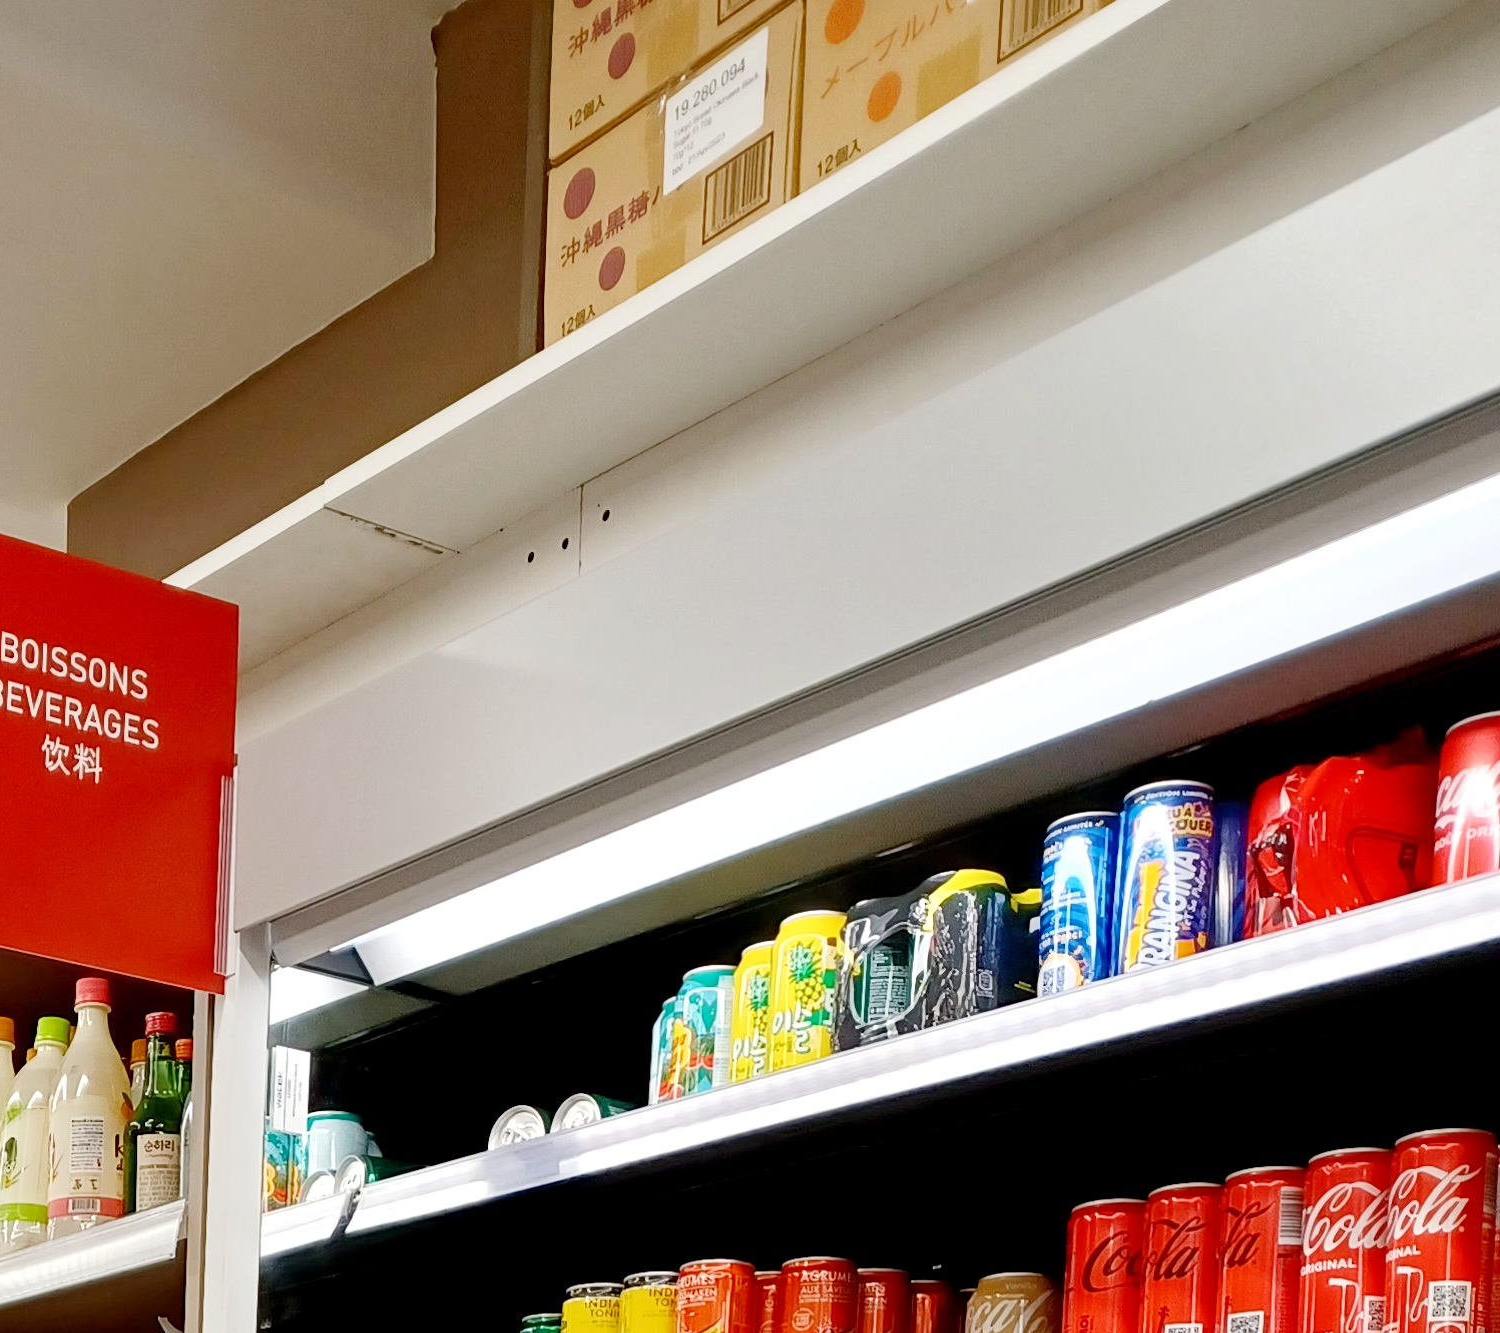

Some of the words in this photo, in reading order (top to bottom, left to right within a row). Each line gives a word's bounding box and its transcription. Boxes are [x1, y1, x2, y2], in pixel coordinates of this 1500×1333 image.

[674, 57, 746, 121] 19.280.094
[0, 631, 149, 700] BOISSONS
[41, 734, 103, 784] 饮料
[1303, 1181, 1390, 1257] Cola
[800, 1270, 856, 1282] AGRUMES
[800, 1286, 819, 1294] AUX
[1300, 1258, 1357, 1277] ORIGINAL
